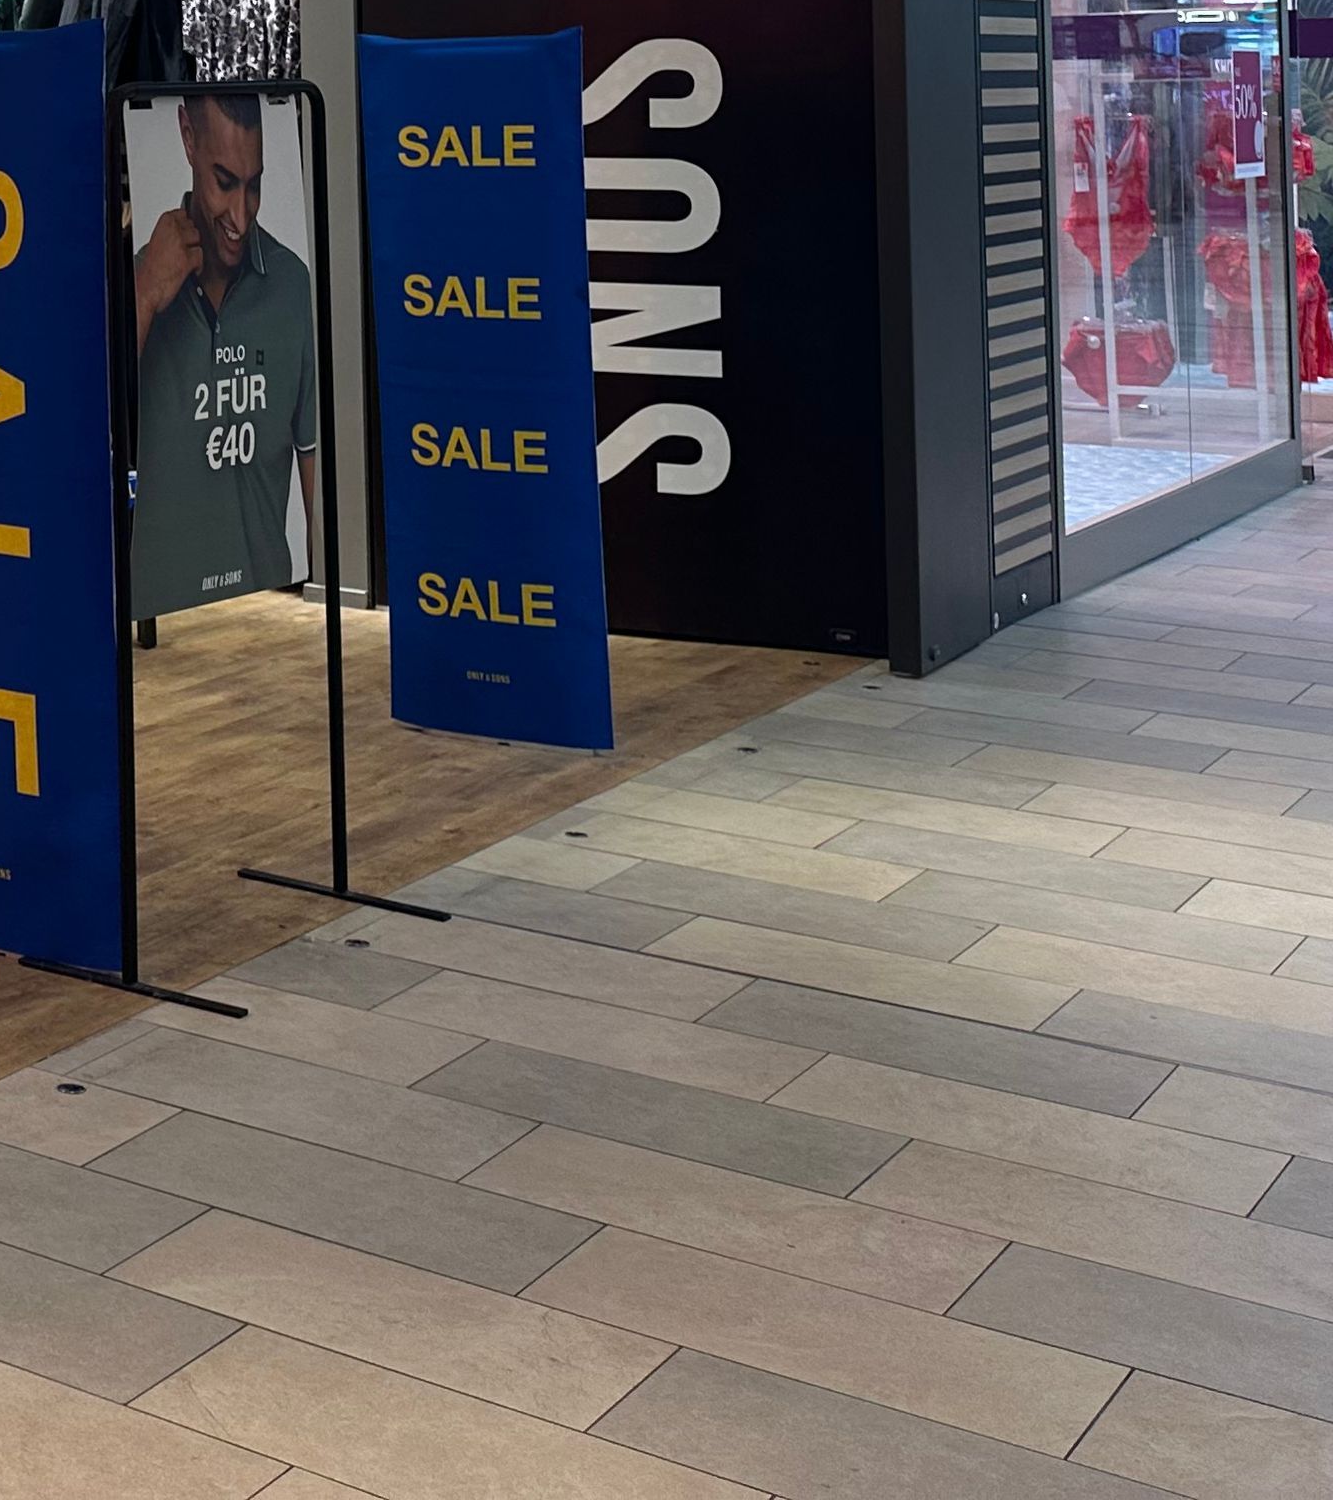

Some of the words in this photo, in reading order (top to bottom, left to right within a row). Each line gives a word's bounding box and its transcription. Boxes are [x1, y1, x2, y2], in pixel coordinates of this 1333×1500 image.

[398, 125, 535, 167] SALE
[403, 274, 542, 319] SALE
[216, 344, 246, 364] POLO
[194, 383, 209, 421] 2
[216, 367, 267, 417] FÜR
[206, 421, 255, 470] €40
[411, 423, 548, 474] SALE
[418, 572, 556, 627] SALE
